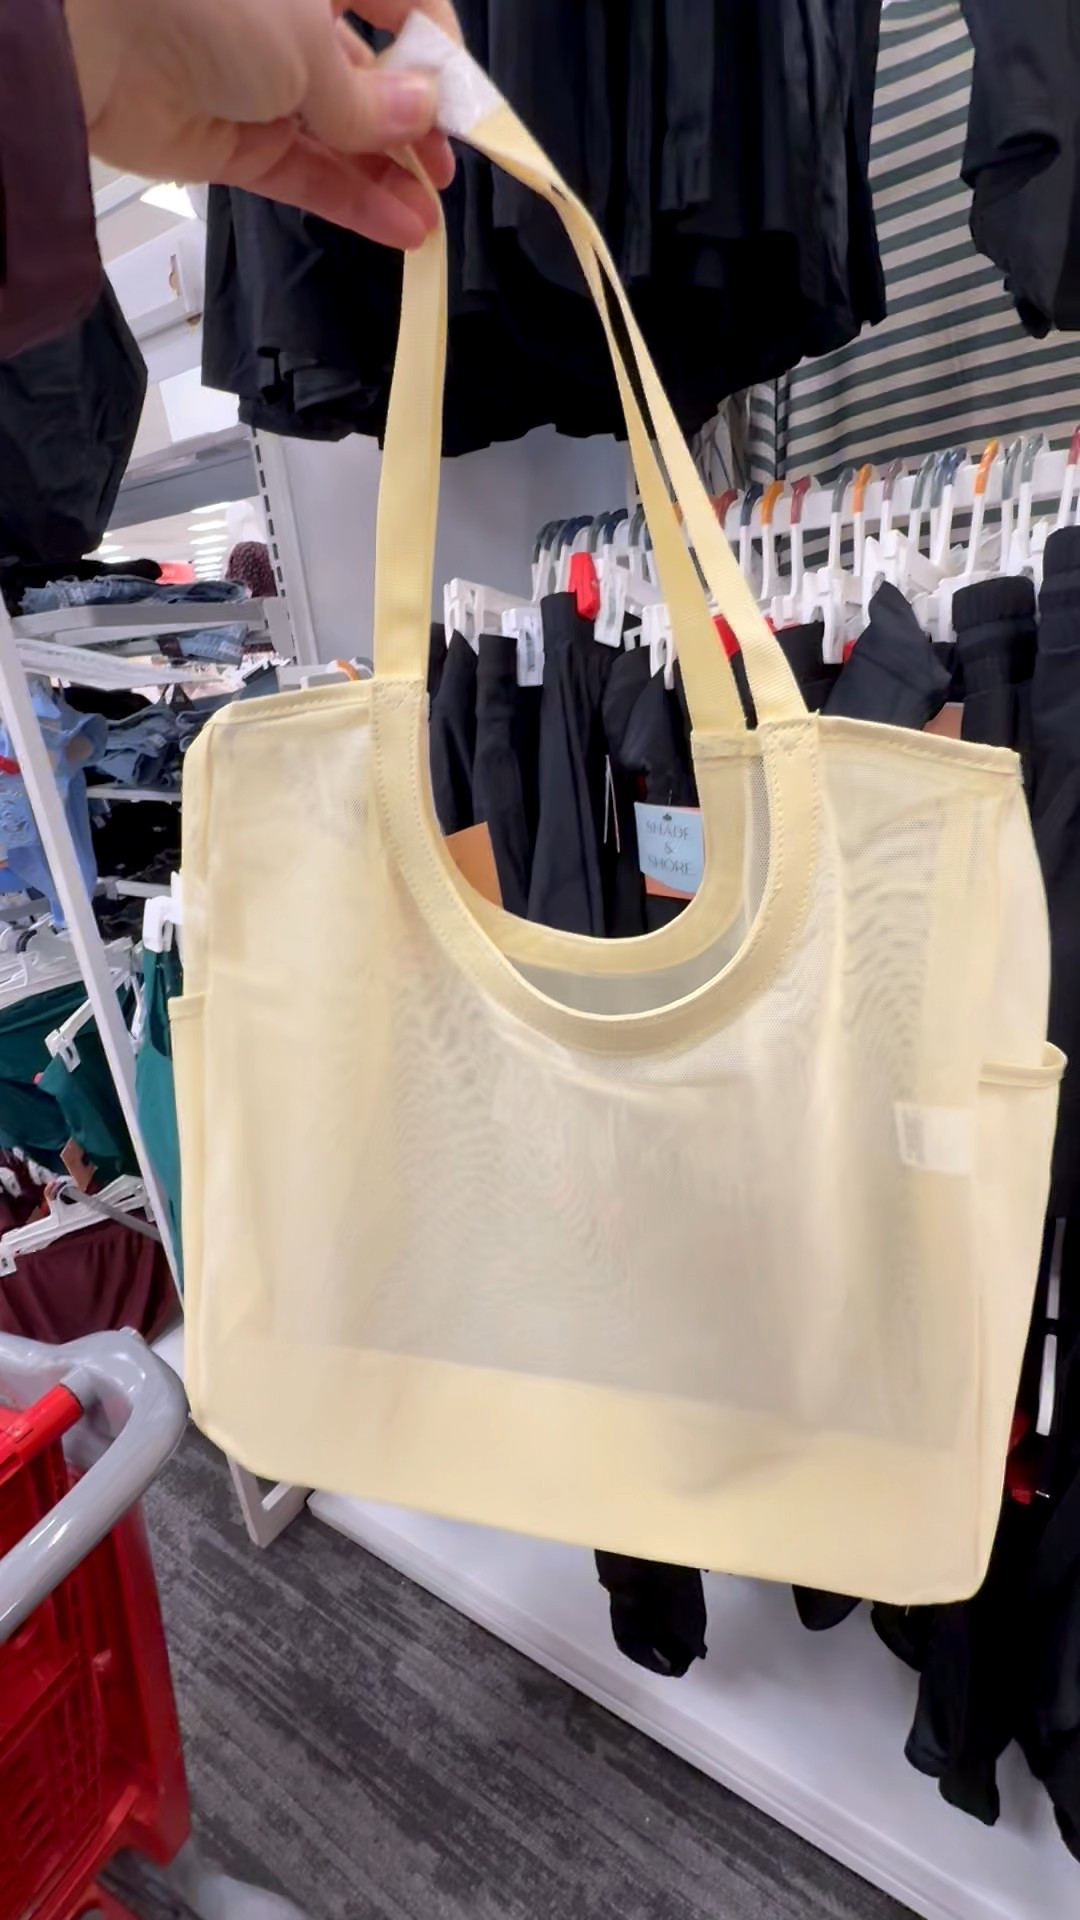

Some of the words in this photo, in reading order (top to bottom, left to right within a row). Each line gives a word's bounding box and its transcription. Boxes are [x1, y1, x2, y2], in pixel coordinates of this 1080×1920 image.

[646, 820, 689, 840] SHADE
[664, 842, 673, 854] &
[647, 855, 691, 875] SHORE
